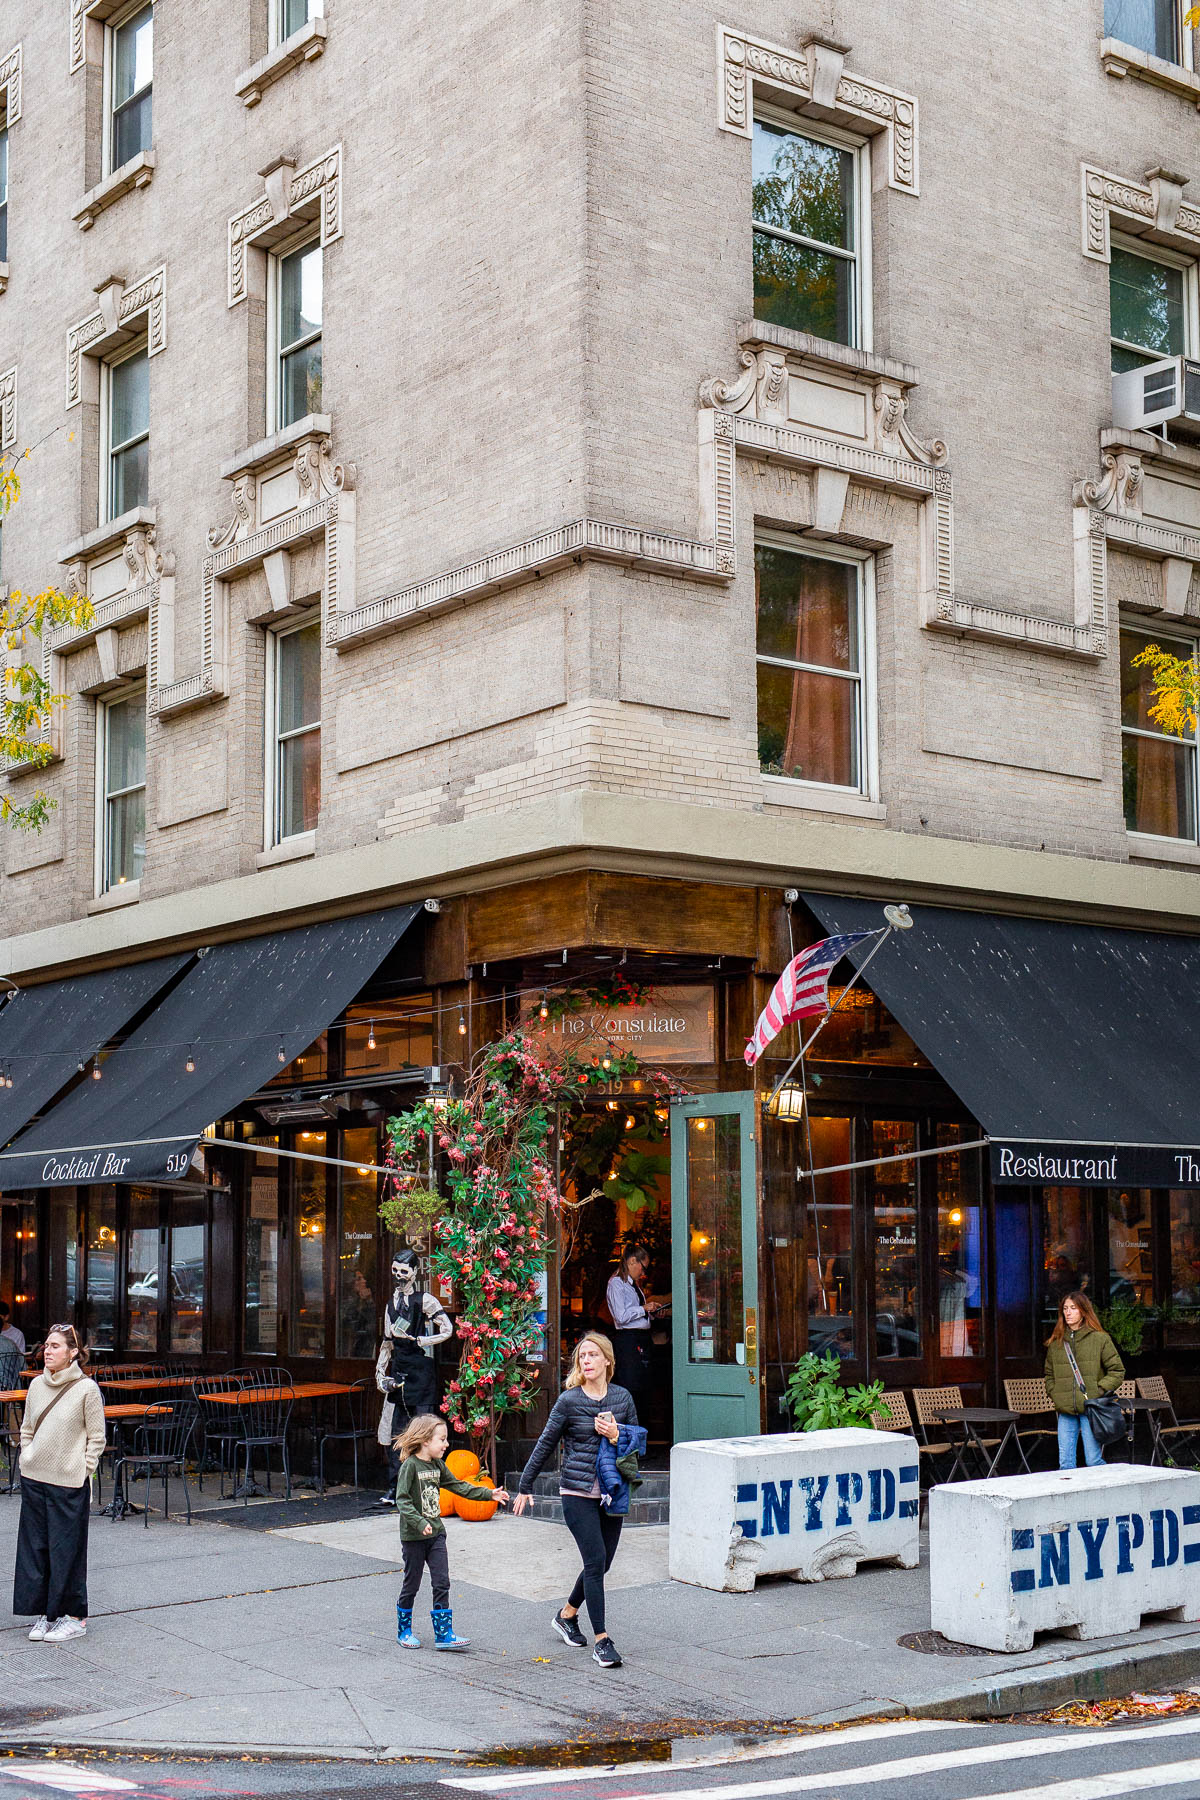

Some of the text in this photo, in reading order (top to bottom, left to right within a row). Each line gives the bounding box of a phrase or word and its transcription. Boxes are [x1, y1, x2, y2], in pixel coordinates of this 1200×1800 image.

[590, 1012, 686, 1034] Consulate
[597, 1079, 623, 1095] 519
[42, 1152, 130, 1181] Cocktail Bar
[166, 1153, 188, 1172] 519
[999, 1148, 1118, 1180] Restaurant
[1174, 1155, 1200, 1182] Th
[879, 1235, 889, 1244] The
[760, 1468, 896, 1537] NYPD
[1038, 1508, 1180, 1588] NYPD
